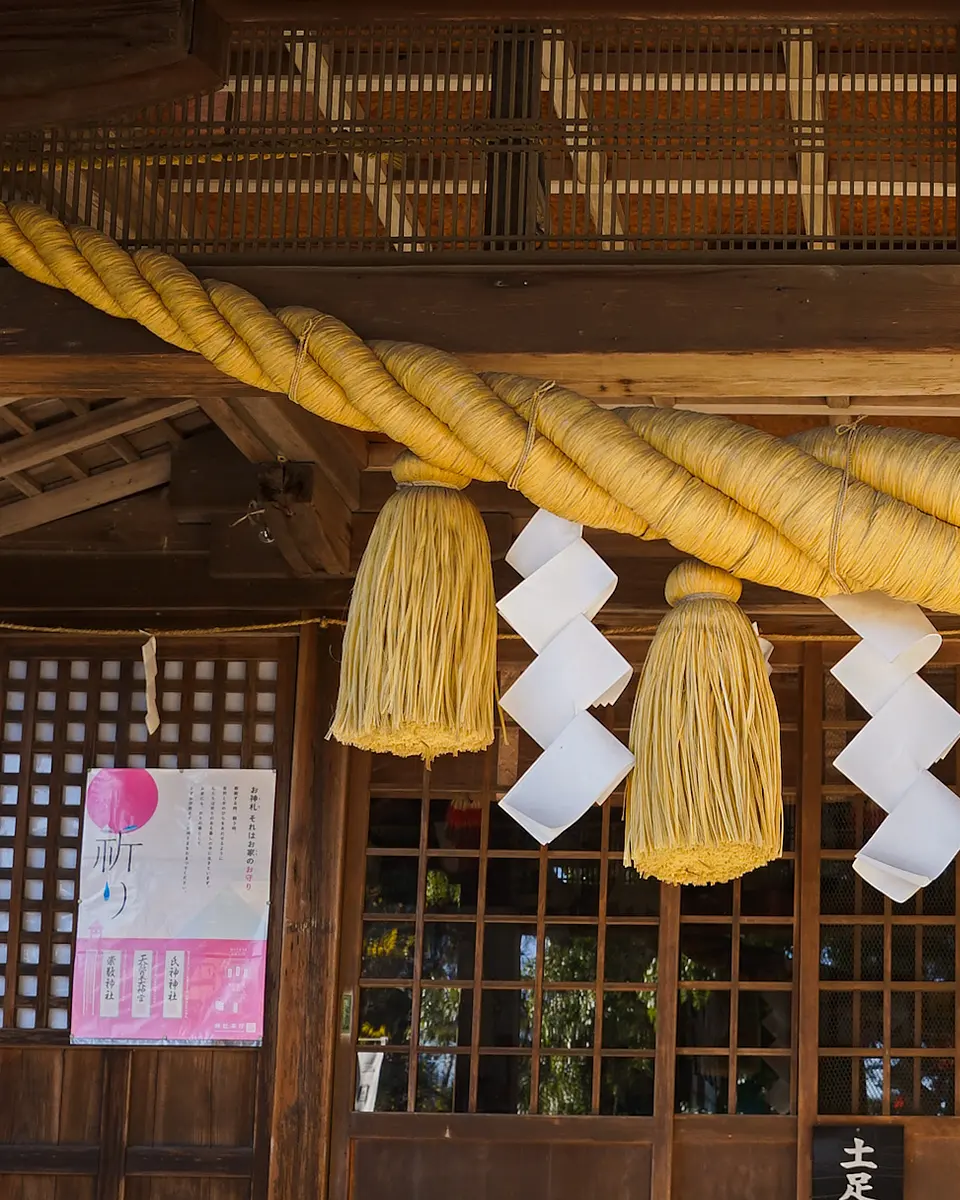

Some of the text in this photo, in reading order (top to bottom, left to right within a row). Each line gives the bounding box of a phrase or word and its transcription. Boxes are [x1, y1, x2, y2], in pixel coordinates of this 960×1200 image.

[93, 831, 143, 919] 祈り
[245, 786, 259, 891] お神札 それはお家のお守り
[167, 956, 180, 1001] 氏神神社
